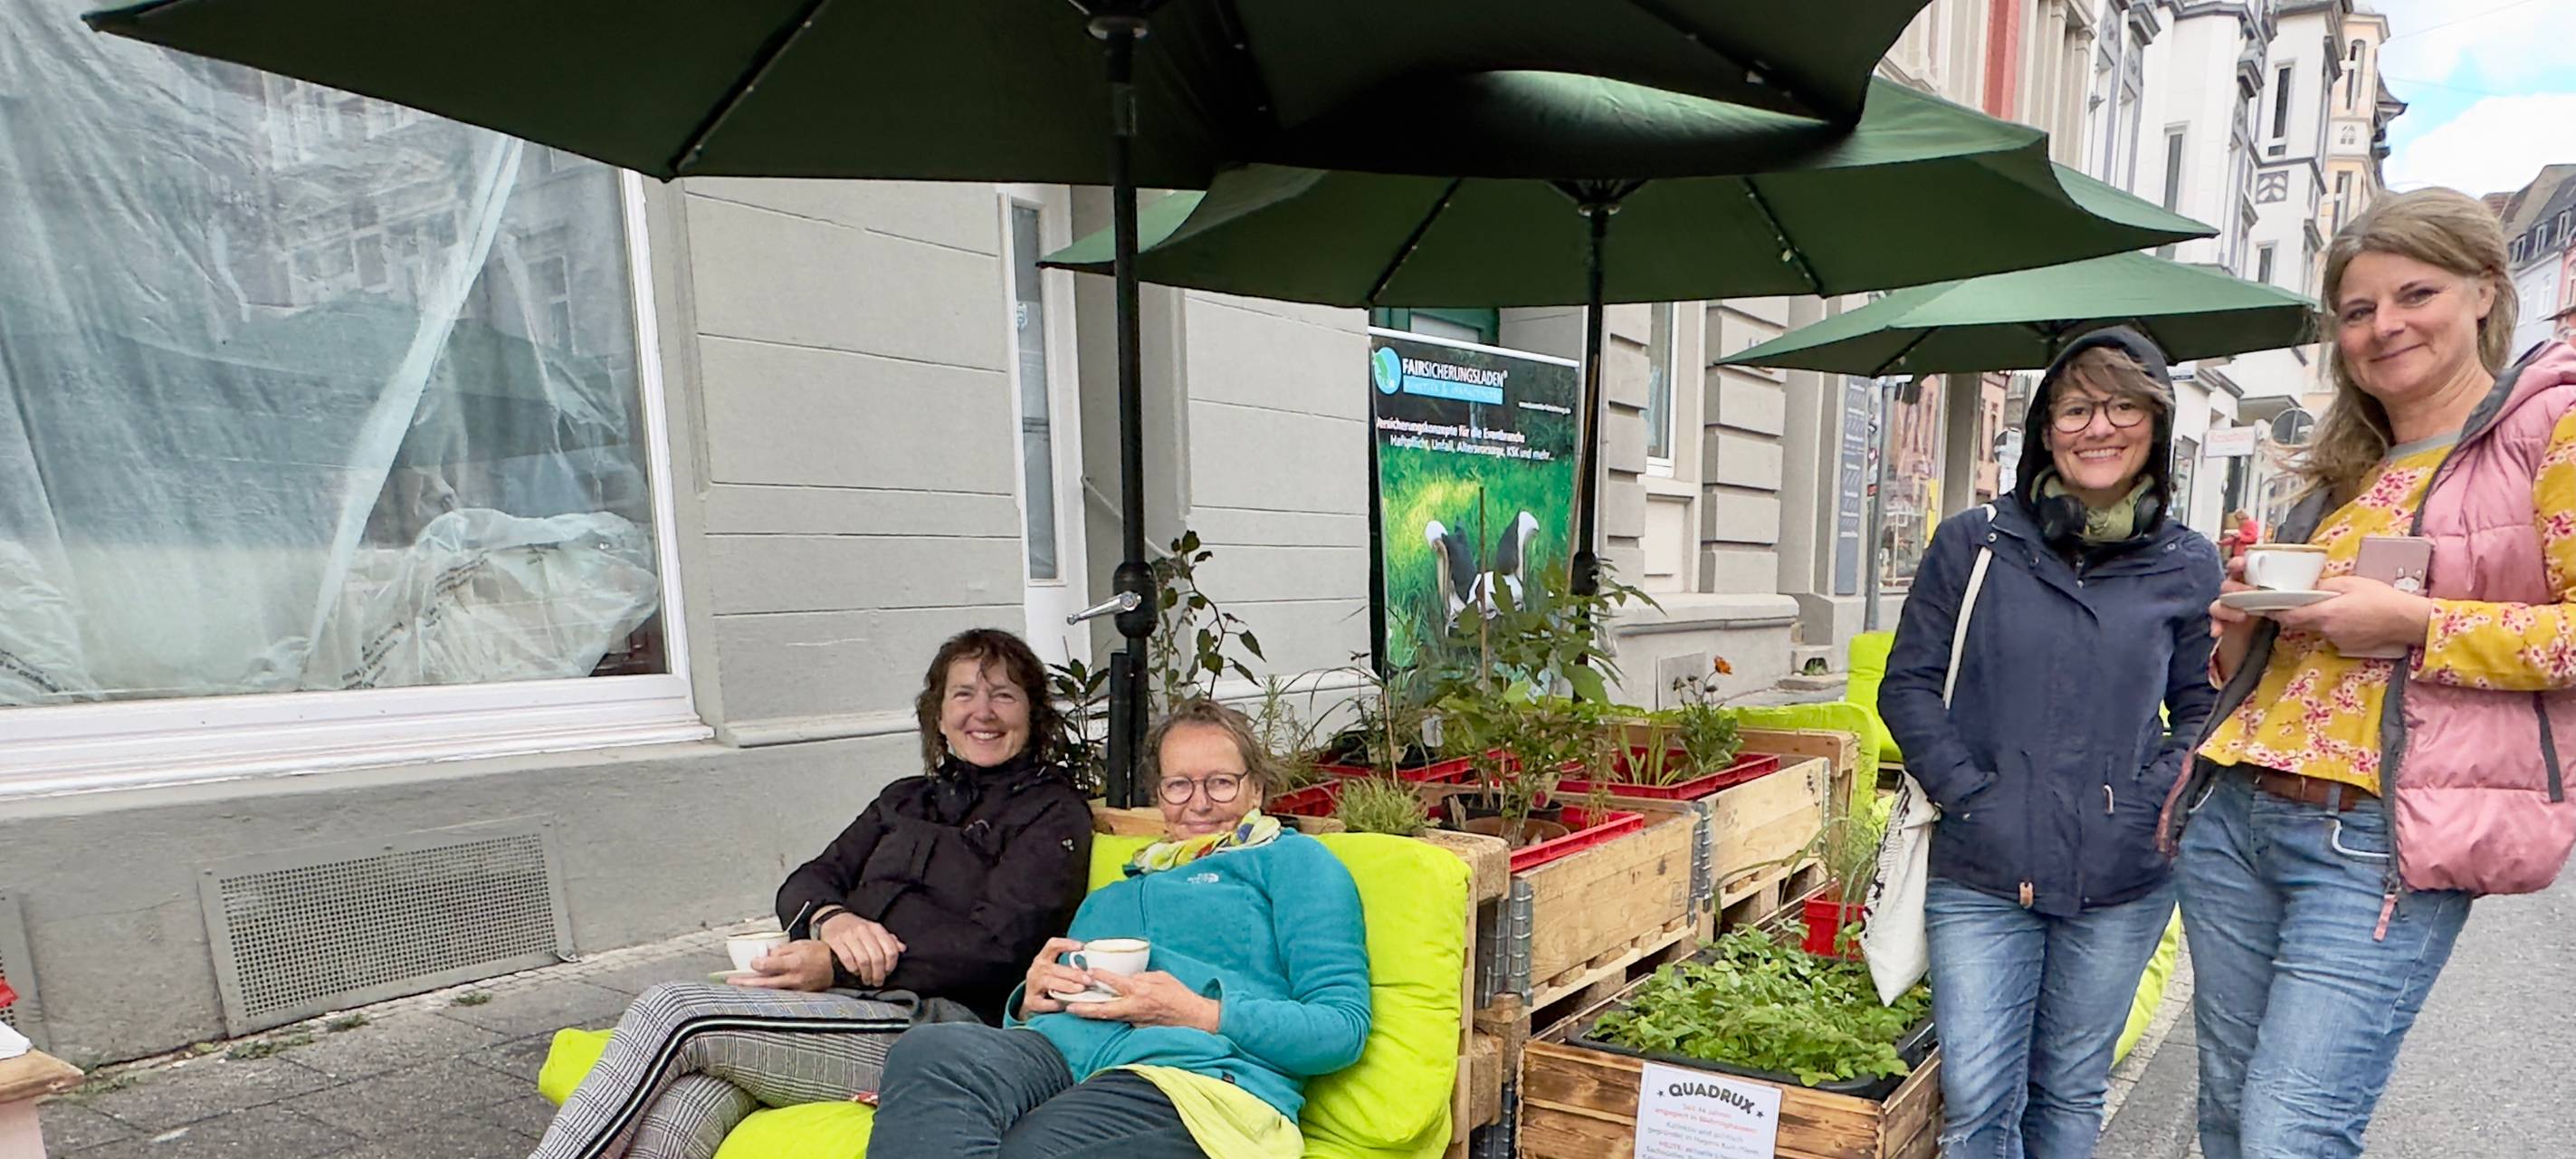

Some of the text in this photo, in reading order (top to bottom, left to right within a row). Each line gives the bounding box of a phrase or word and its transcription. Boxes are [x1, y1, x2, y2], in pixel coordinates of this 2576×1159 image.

[1506, 445, 1520, 457] KSK
[1520, 447, 1532, 459] und
[1668, 1082, 1756, 1115] QUADRUX
